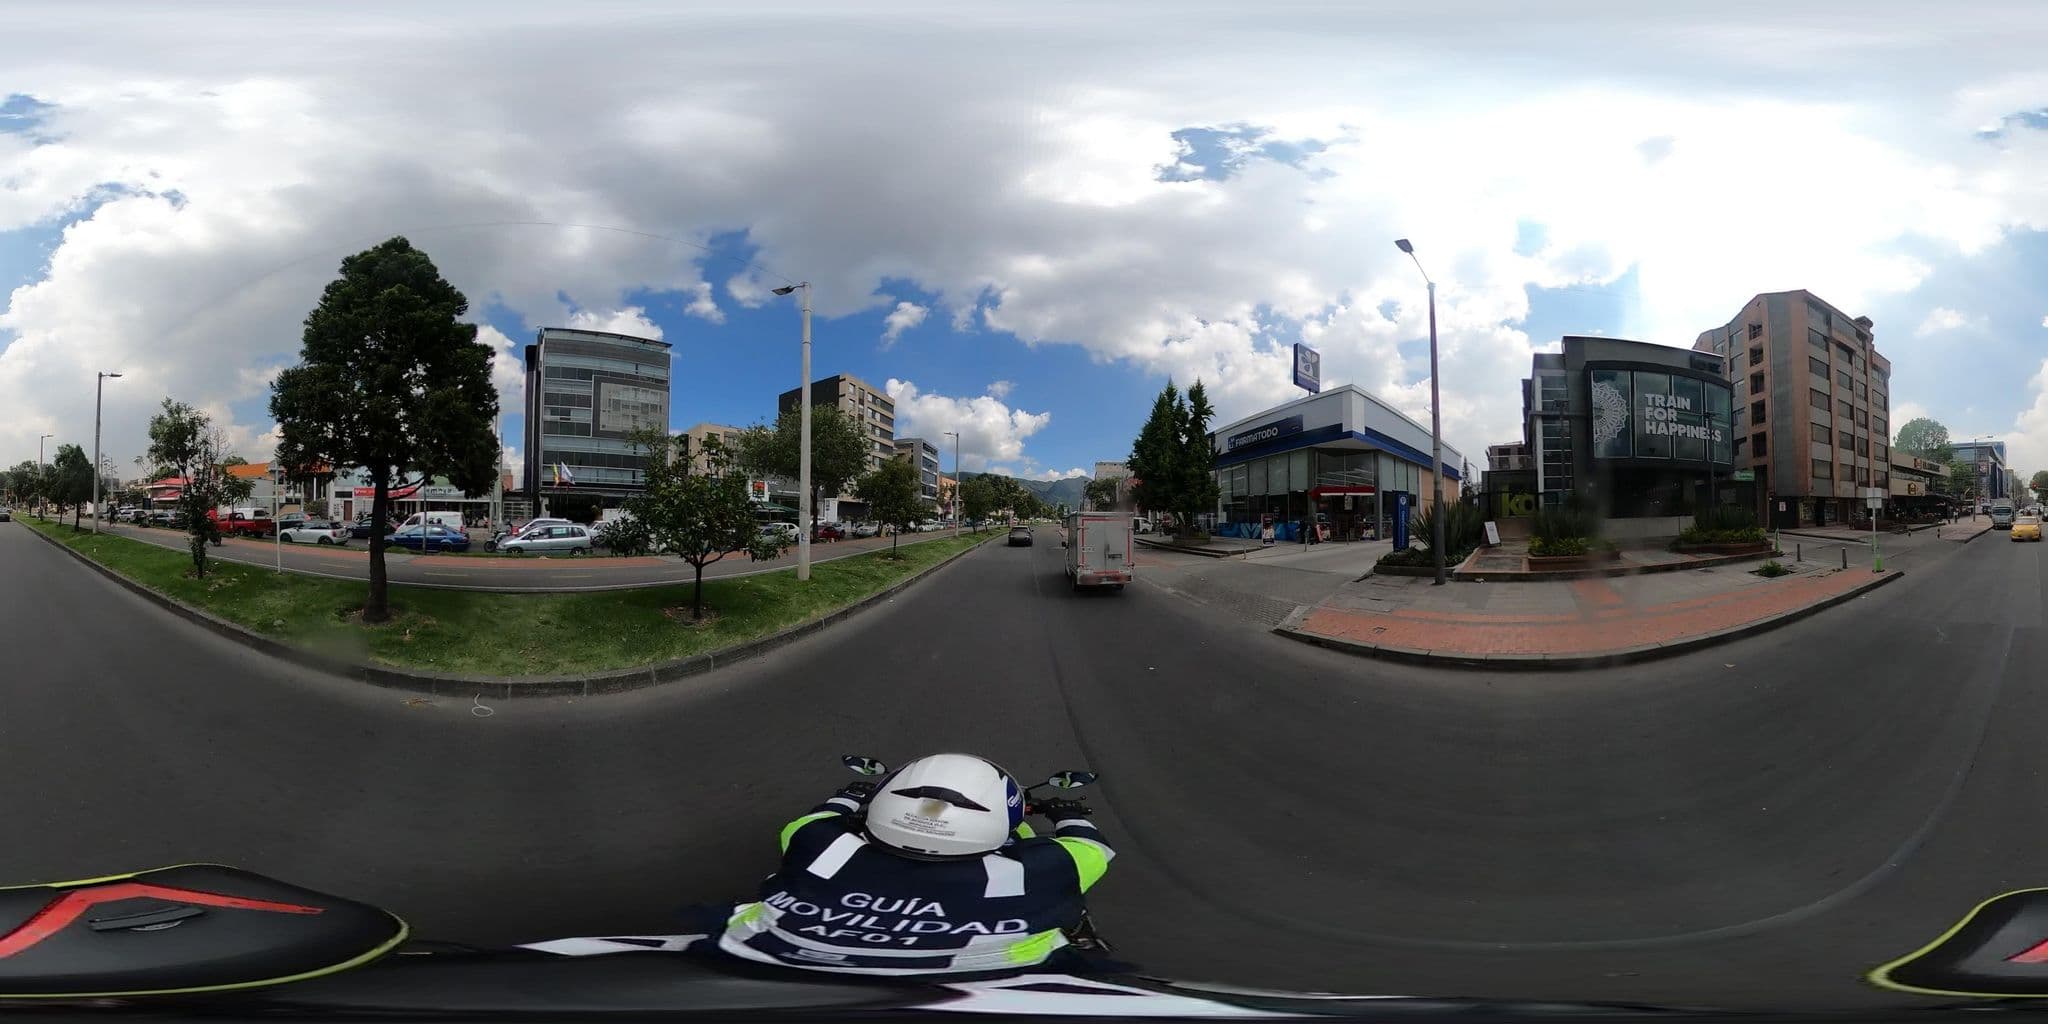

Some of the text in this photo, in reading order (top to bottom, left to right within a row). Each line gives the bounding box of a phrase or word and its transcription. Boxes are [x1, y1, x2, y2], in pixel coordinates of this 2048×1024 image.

[1645, 393, 1691, 410] TRAIN
[1645, 407, 1678, 422] FOR
[1236, 427, 1279, 448] FARMATODO
[1645, 421, 1722, 442] HAPPINESS
[765, 890, 1029, 935] MOVILIDAD
[841, 891, 946, 918] GUÍA
